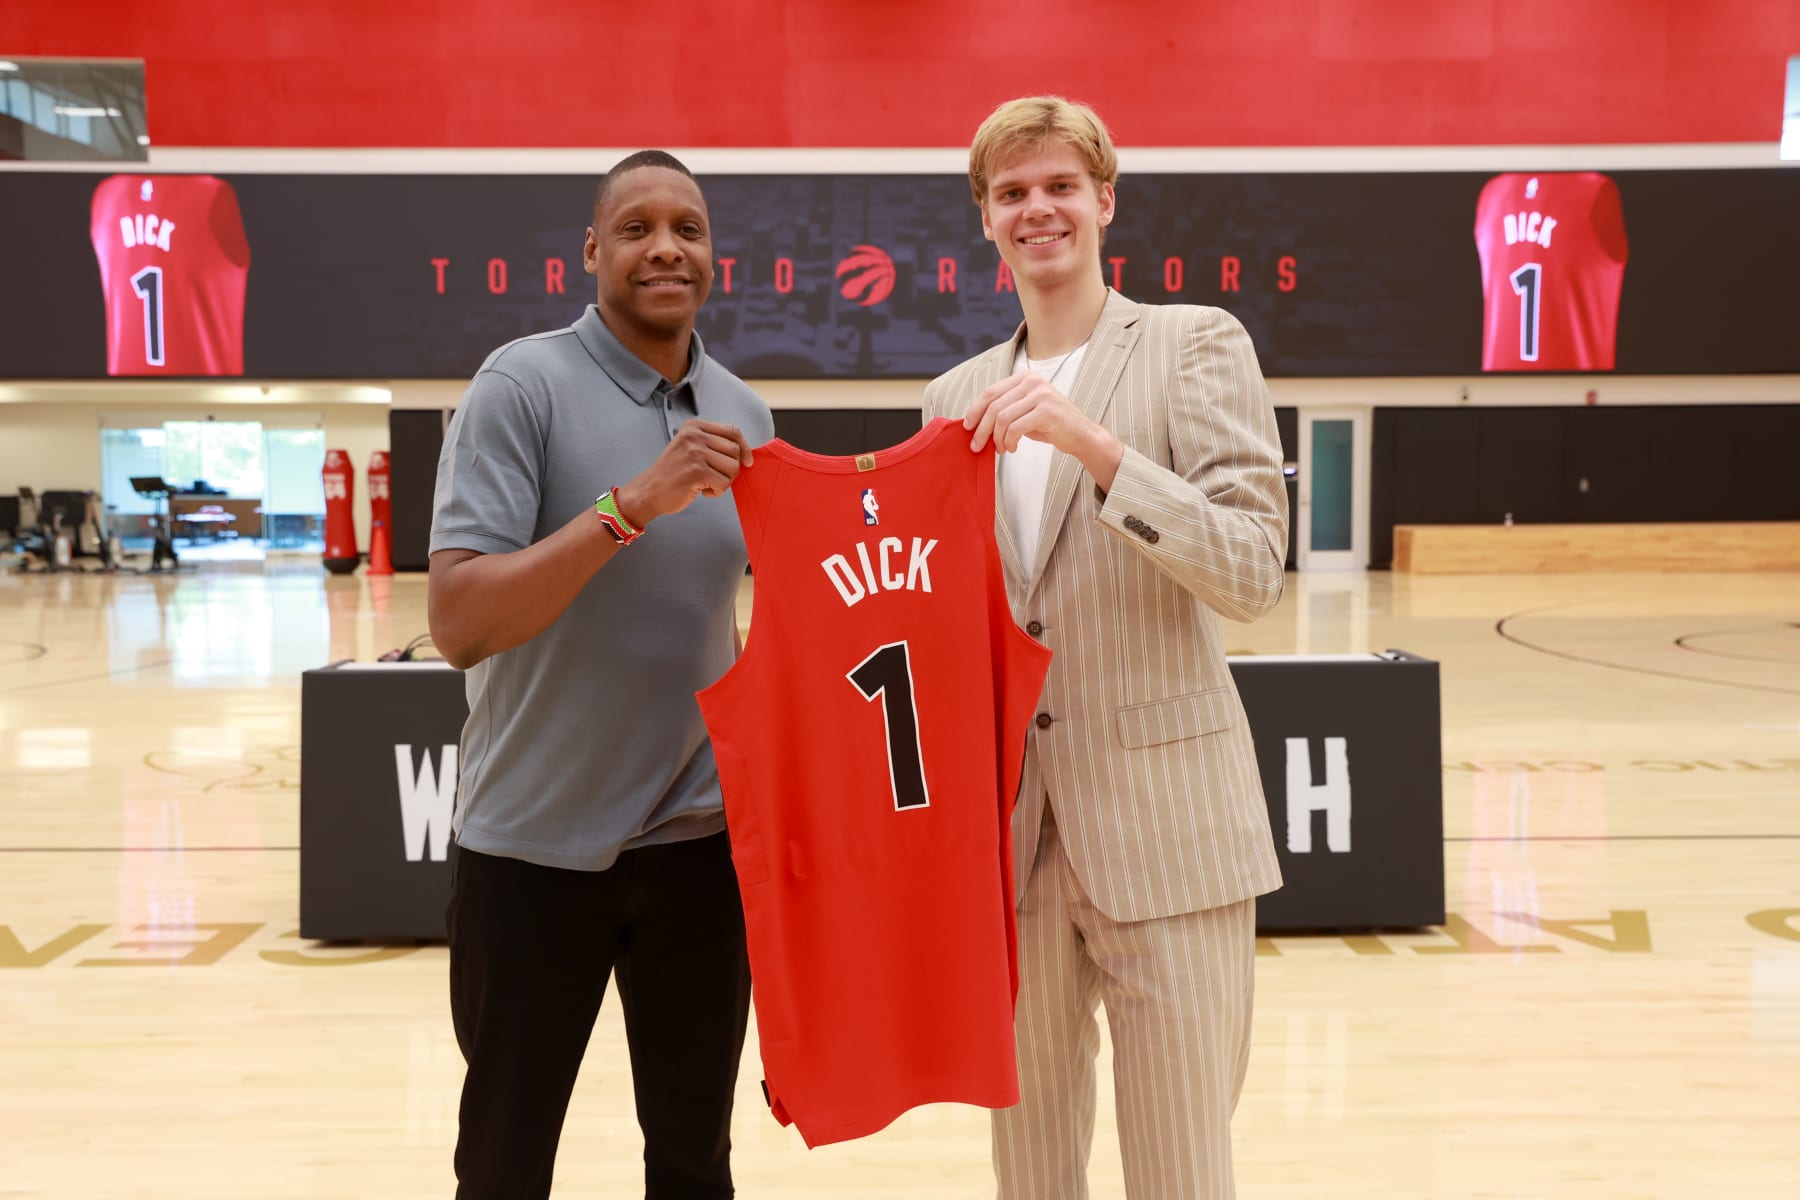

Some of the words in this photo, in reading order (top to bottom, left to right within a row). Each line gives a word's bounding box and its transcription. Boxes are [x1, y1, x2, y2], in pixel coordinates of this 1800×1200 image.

[120, 213, 175, 252] DICK
[1503, 211, 1557, 249] DICK
[430, 257, 794, 294] TORTO
[938, 256, 1298, 293] RATORS
[130, 265, 165, 367] 1
[1509, 262, 1542, 361] 1
[821, 536, 938, 607] DICK
[846, 640, 930, 811] 1
